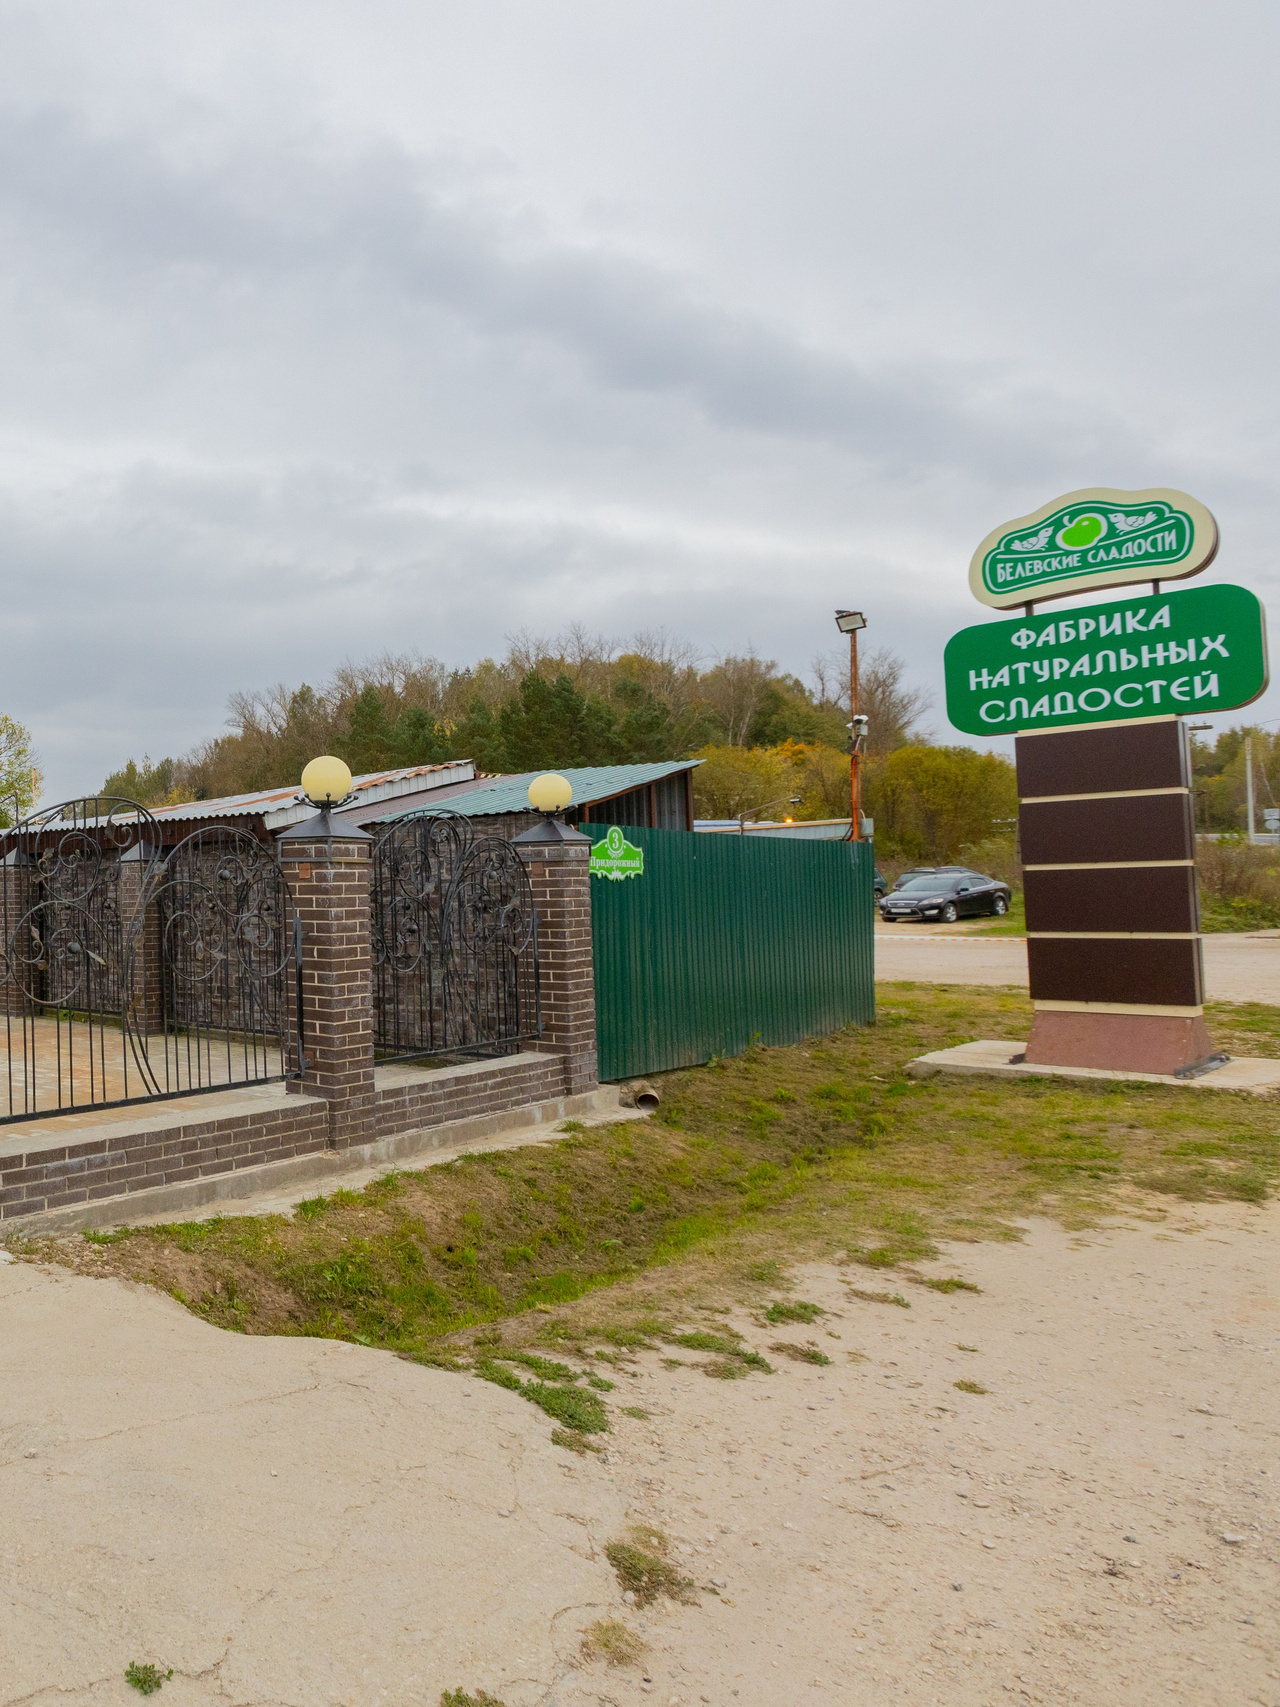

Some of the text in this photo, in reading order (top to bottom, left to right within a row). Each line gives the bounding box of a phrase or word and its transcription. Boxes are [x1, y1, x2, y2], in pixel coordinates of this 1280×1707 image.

[996, 529, 1177, 583] БЕЛЕВСКИЕ СЛАДОСТИ
[1010, 605, 1170, 650] ФАБРИКА
[969, 634, 1230, 691] НАТУРАЛЬНЫХ
[979, 670, 1219, 723] СЛАДОСТЕЙ
[590, 856, 640, 869] Придорожный
[612, 832, 619, 849] 3
